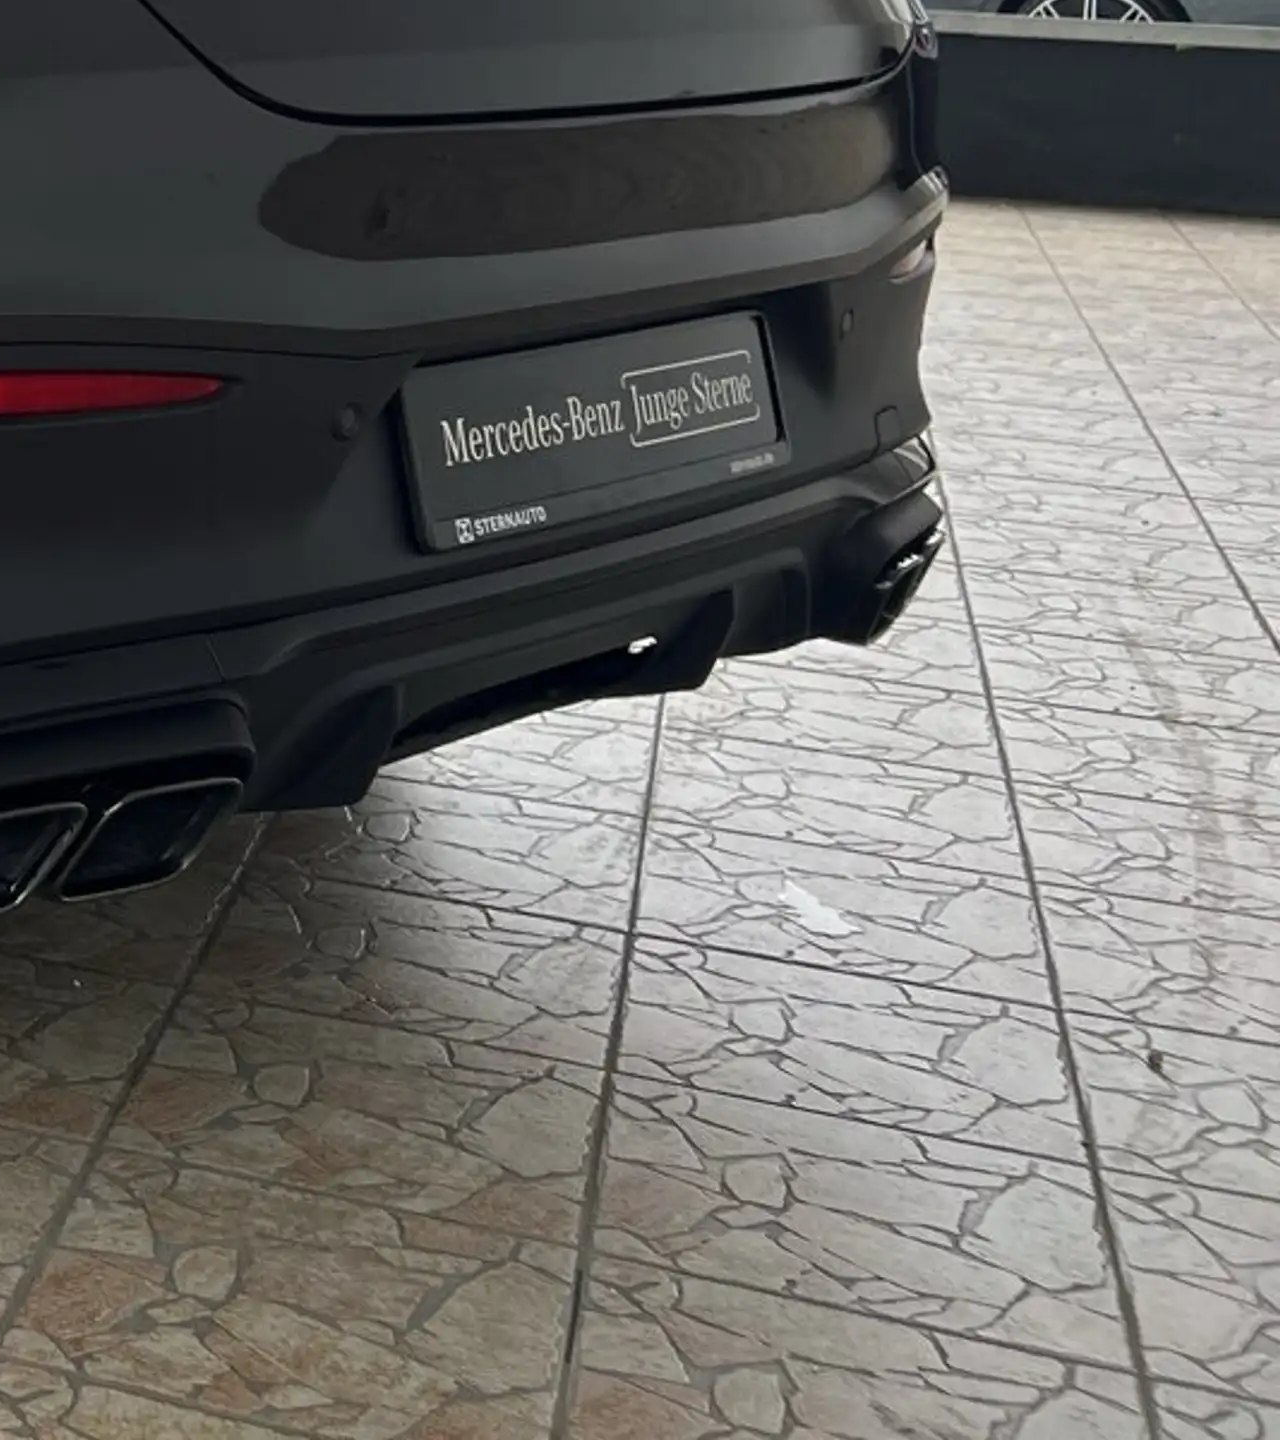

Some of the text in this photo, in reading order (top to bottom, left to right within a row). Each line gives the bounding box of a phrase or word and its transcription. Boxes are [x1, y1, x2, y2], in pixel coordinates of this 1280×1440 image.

[441, 371, 754, 466] Mercedes-Benz Junge Sterne
[474, 506, 547, 536] STERNAUTO
